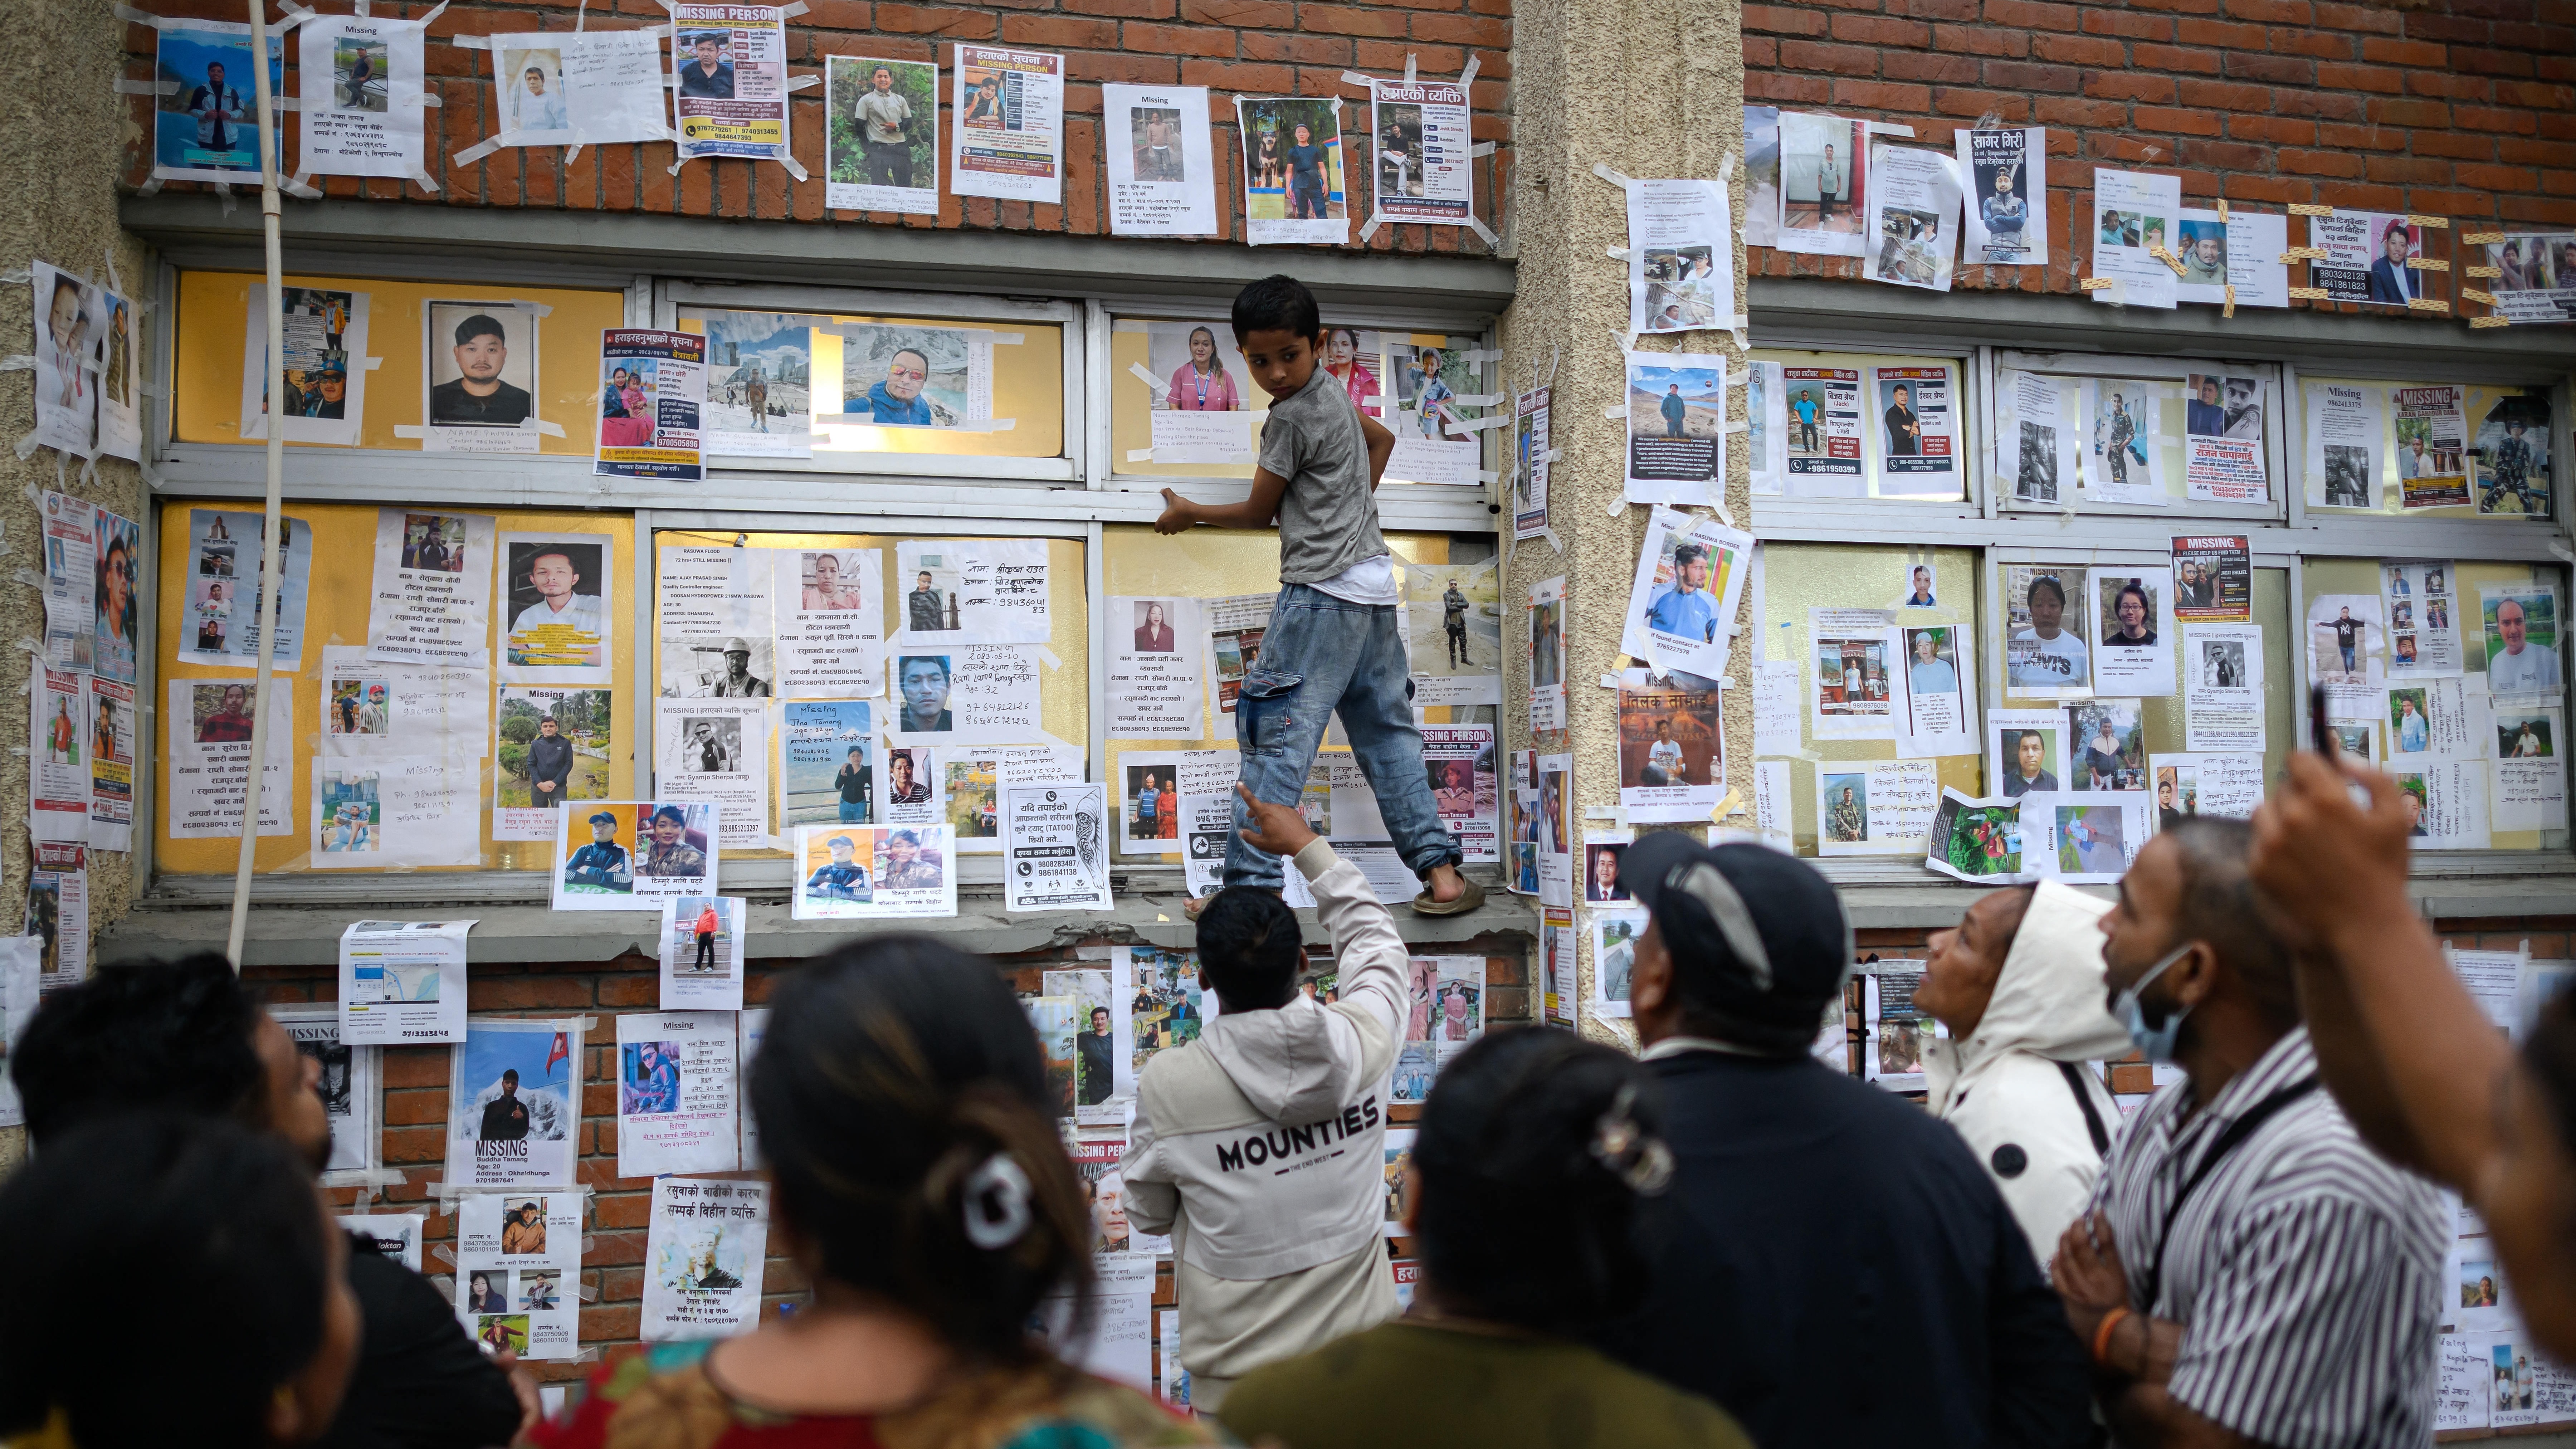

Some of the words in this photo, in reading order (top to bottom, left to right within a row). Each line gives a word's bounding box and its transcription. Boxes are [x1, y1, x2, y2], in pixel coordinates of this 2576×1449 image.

[677, 7, 725, 19] MISSING
[729, 9, 776, 20] PERSON
[346, 26, 377, 35] Missing
[976, 51, 1010, 62] हराएको
[1013, 55, 1040, 64] सूचना
[977, 60, 1013, 69] MISSING
[1015, 64, 1048, 73] PERSON
[1142, 96, 1168, 105] Missing
[1973, 136, 1999, 149] सागर
[2002, 132, 2023, 148] गिरी
[2320, 269, 2365, 280] 9803242125
[2320, 279, 2366, 290] 9841861823
[670, 336, 693, 348] सूचना
[2328, 387, 2361, 401] Missing
[2402, 389, 2451, 405] MISSING
[2327, 399, 2361, 408] 9862413375
[658, 438, 698, 448] 9700505896
[1694, 533, 1718, 543] RASUWA
[1718, 541, 1741, 550] BORDER
[2187, 538, 2235, 548] MISSING
[1656, 633, 1672, 642] found
[1673, 639, 1692, 648] contact
[1657, 642, 1690, 655] 9765227578
[529, 690, 565, 701] Missing
[700, 706, 723, 714] हराएको
[1452, 731, 1485, 741] PERSON
[406, 766, 444, 776] Missing
[1020, 804, 1035, 812] यदि
[1046, 823, 1074, 833] (TATOO)
[663, 1020, 694, 1031] Missing
[1215, 1094, 1380, 1172] MOUNTIES
[475, 1139, 528, 1158] MISSING
[1107, 1143, 1127, 1157] PER
[1315, 1154, 1330, 1165] WEST
